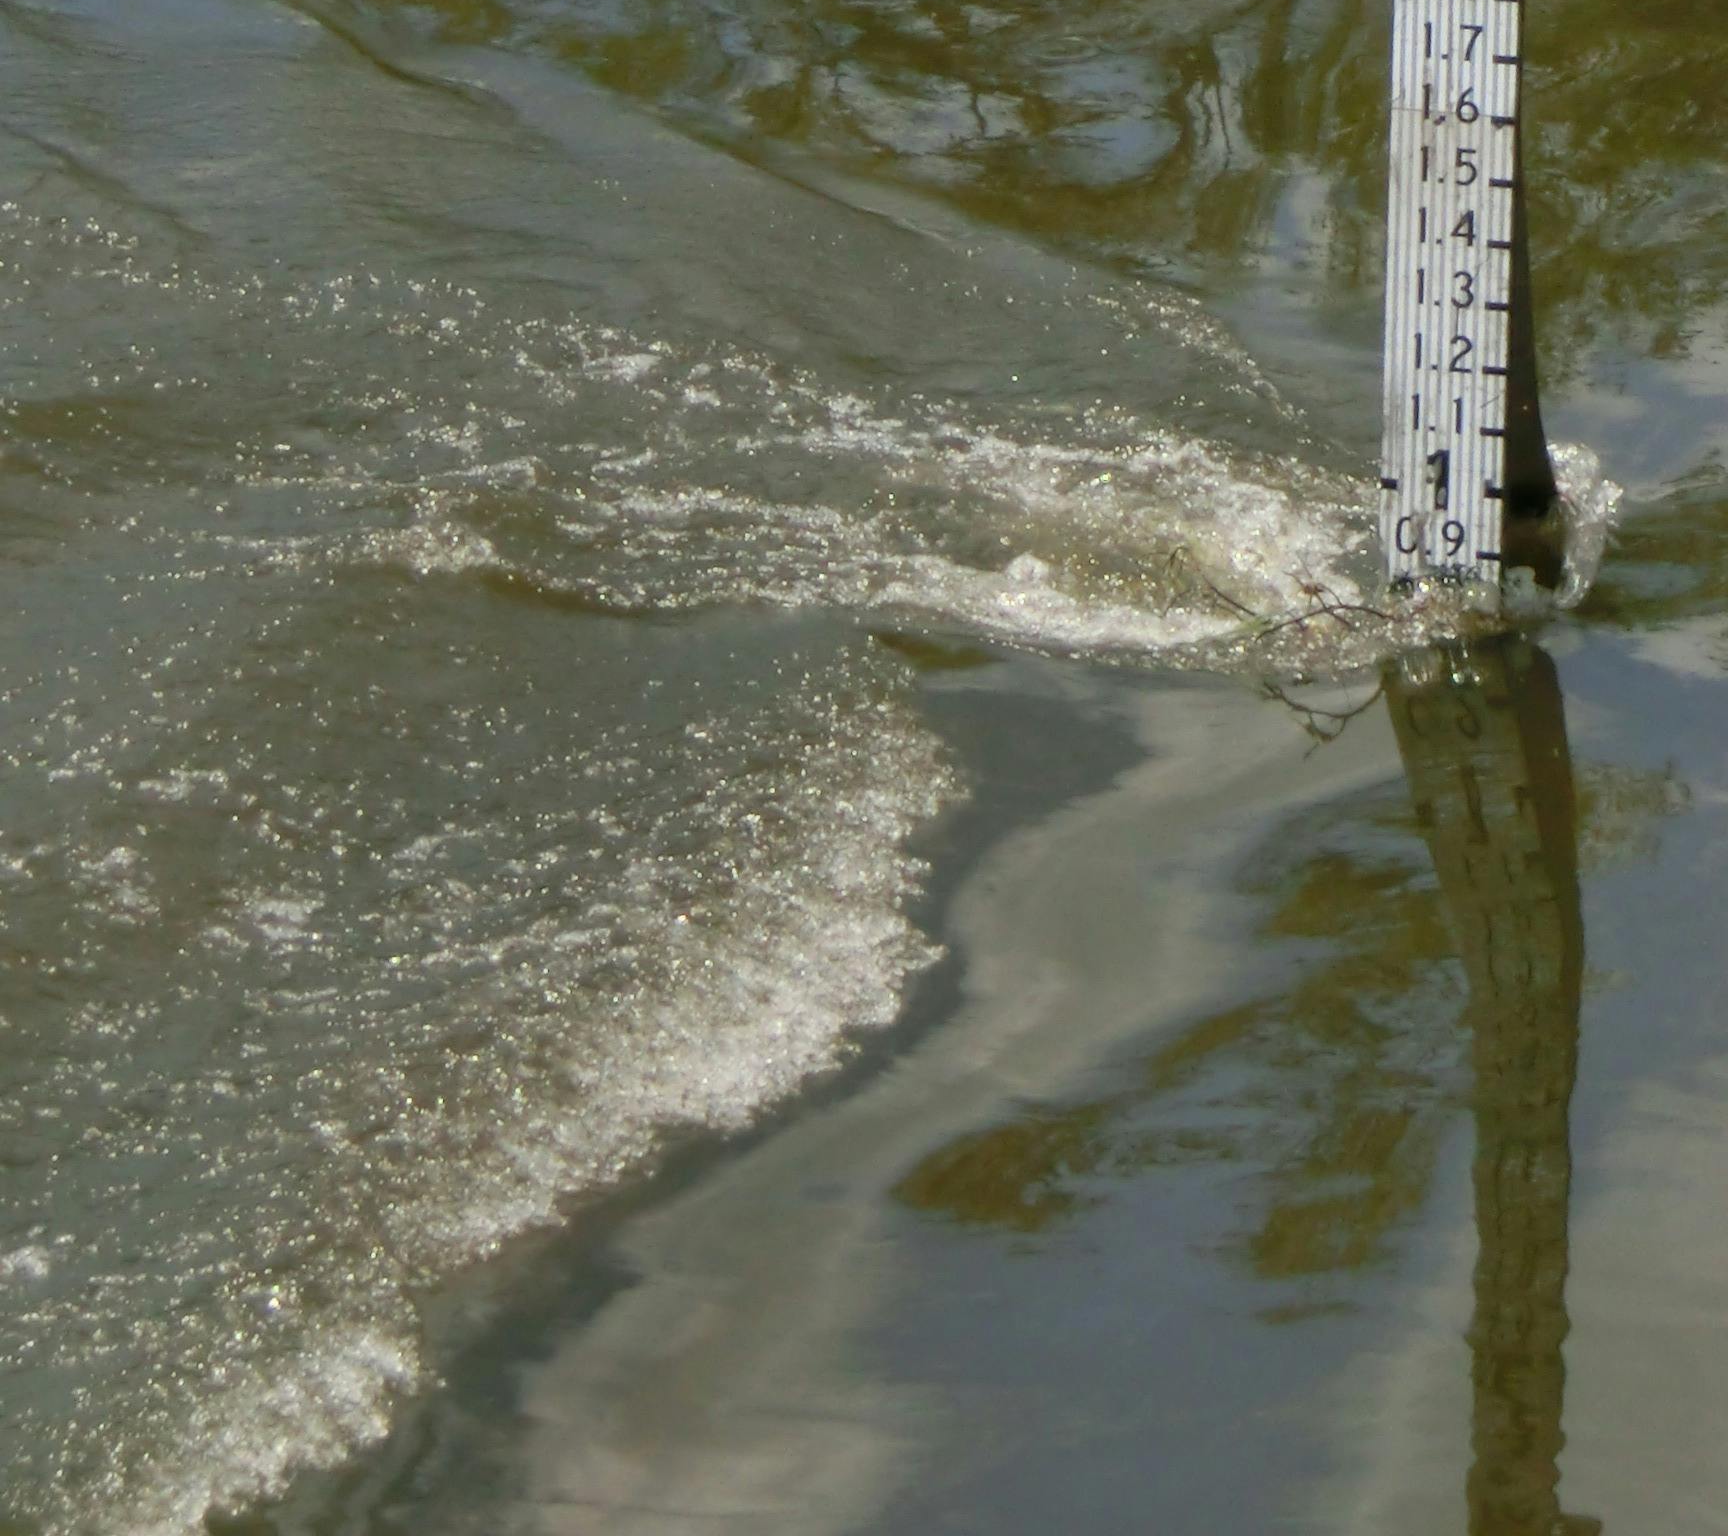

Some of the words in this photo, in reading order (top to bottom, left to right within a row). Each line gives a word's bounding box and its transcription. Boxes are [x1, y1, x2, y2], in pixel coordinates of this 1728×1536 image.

[1423, 21, 1484, 63] 1.7
[1421, 82, 1481, 125] 1.6
[1419, 145, 1479, 187] 1.5
[1417, 206, 1477, 247] 1.4
[1415, 267, 1475, 309] 1.3
[1413, 331, 1472, 374] 1.2
[1411, 393, 1463, 435] 1.1
[1425, 449, 1451, 512] 1
[1395, 514, 1466, 558] 0.9
